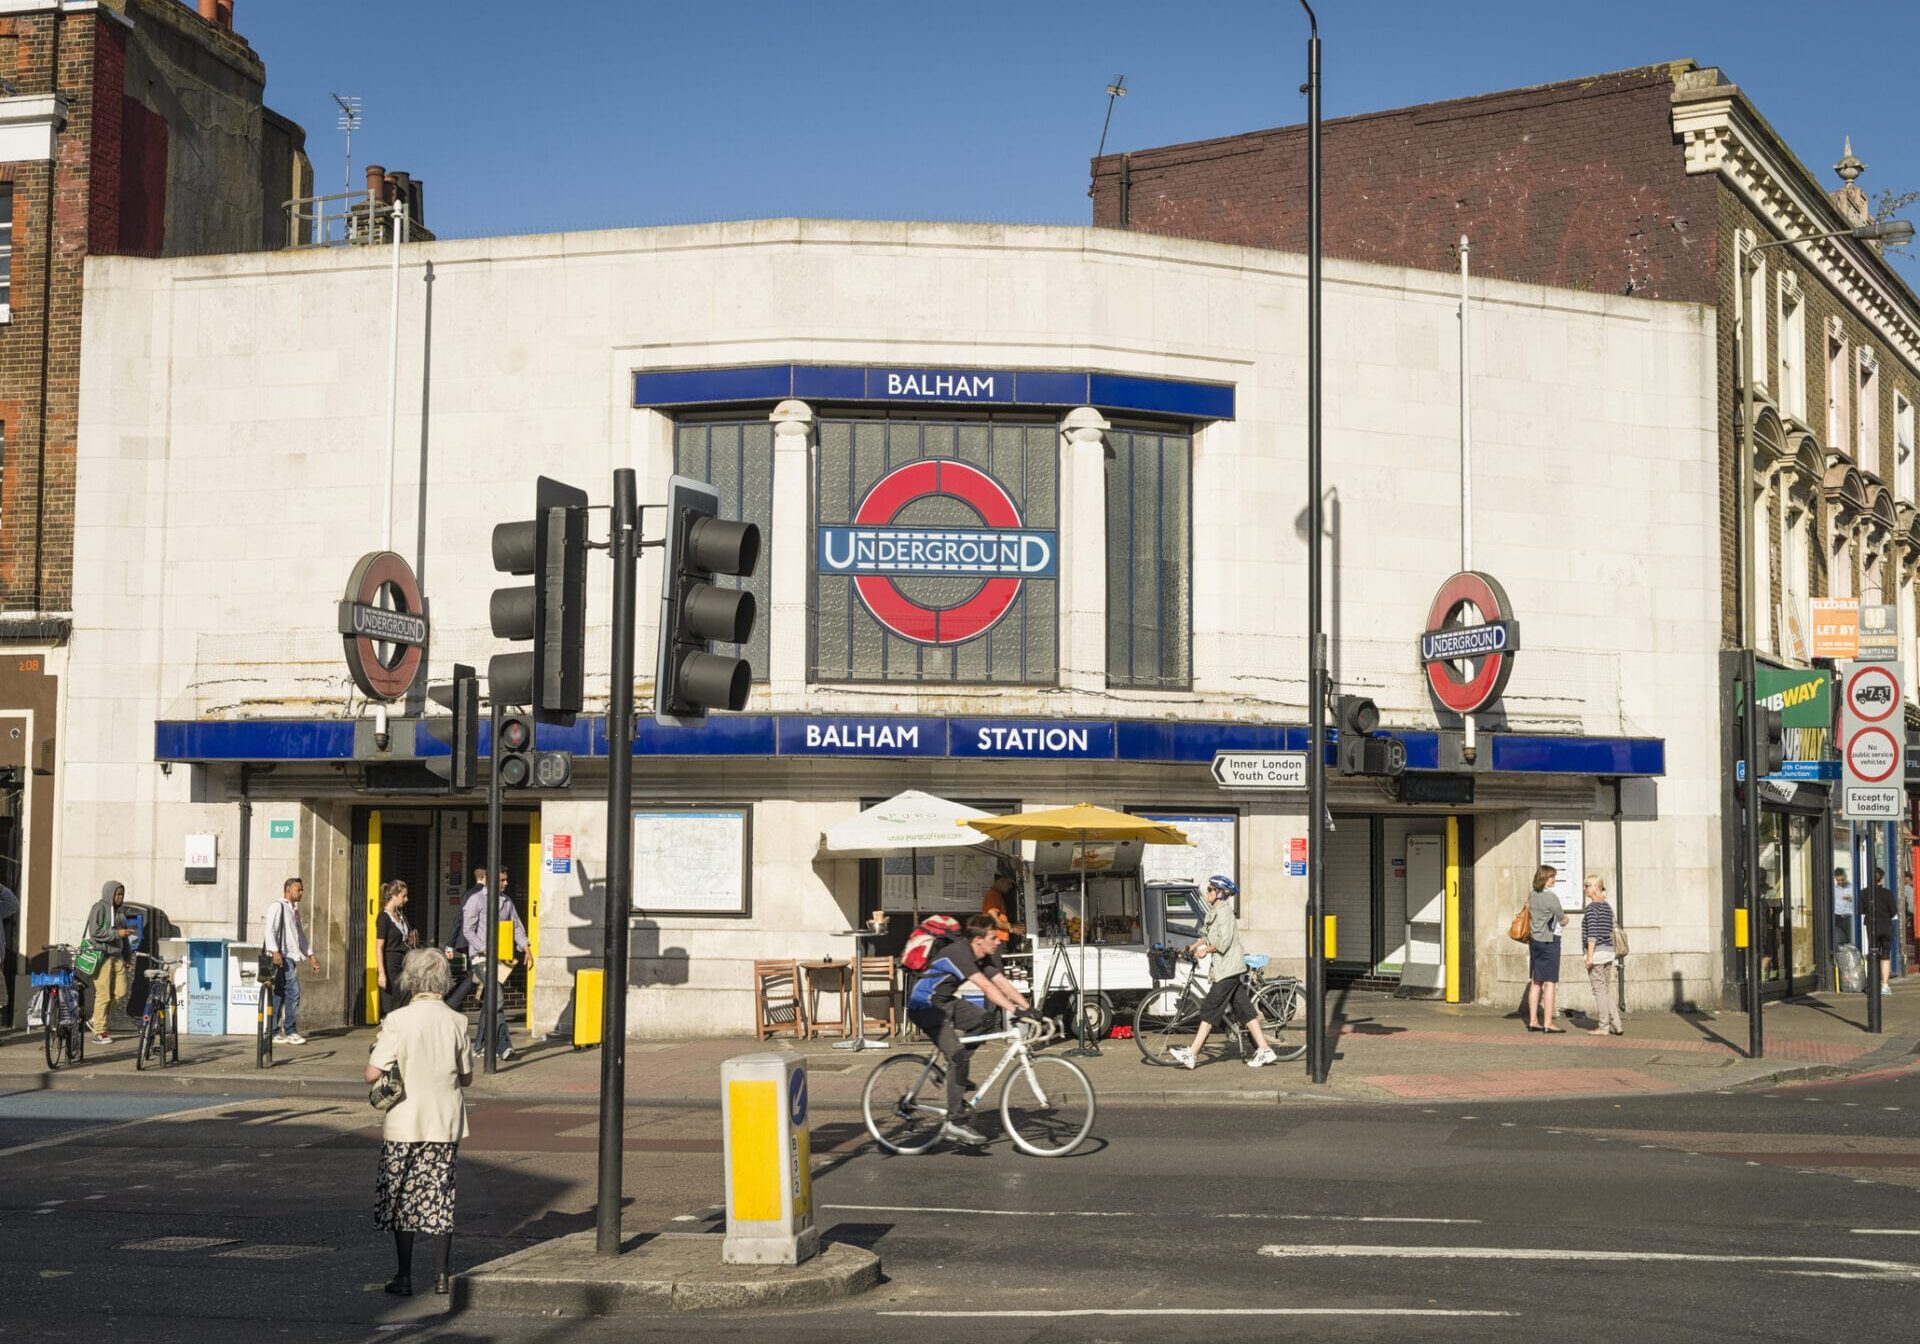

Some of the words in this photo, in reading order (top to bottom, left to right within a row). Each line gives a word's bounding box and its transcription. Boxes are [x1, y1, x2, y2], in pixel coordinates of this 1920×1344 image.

[888, 374, 995, 398] BALHAM
[825, 531, 1050, 572] UNDERGROUND
[353, 605, 426, 643] UNDERGROUND
[1817, 624, 1837, 635] LET
[1840, 624, 1856, 635] BY
[1422, 625, 1506, 659] UNDERGROUND
[1755, 677, 1824, 712] UBWAY
[806, 725, 919, 748] BALHAM
[977, 727, 1088, 751] STATION
[1852, 751, 1871, 759] public
[1230, 759, 1258, 769] Inner
[1262, 759, 1302, 769] London
[1232, 770, 1264, 781] Youth
[1267, 770, 1299, 781] Court
[1763, 782, 1792, 798] Toilets
[1851, 793, 1881, 803] Except
[1882, 793, 1895, 802] for
[1857, 803, 1890, 812] loading
[275, 825, 289, 833] RVP
[192, 852, 209, 864] LFB
